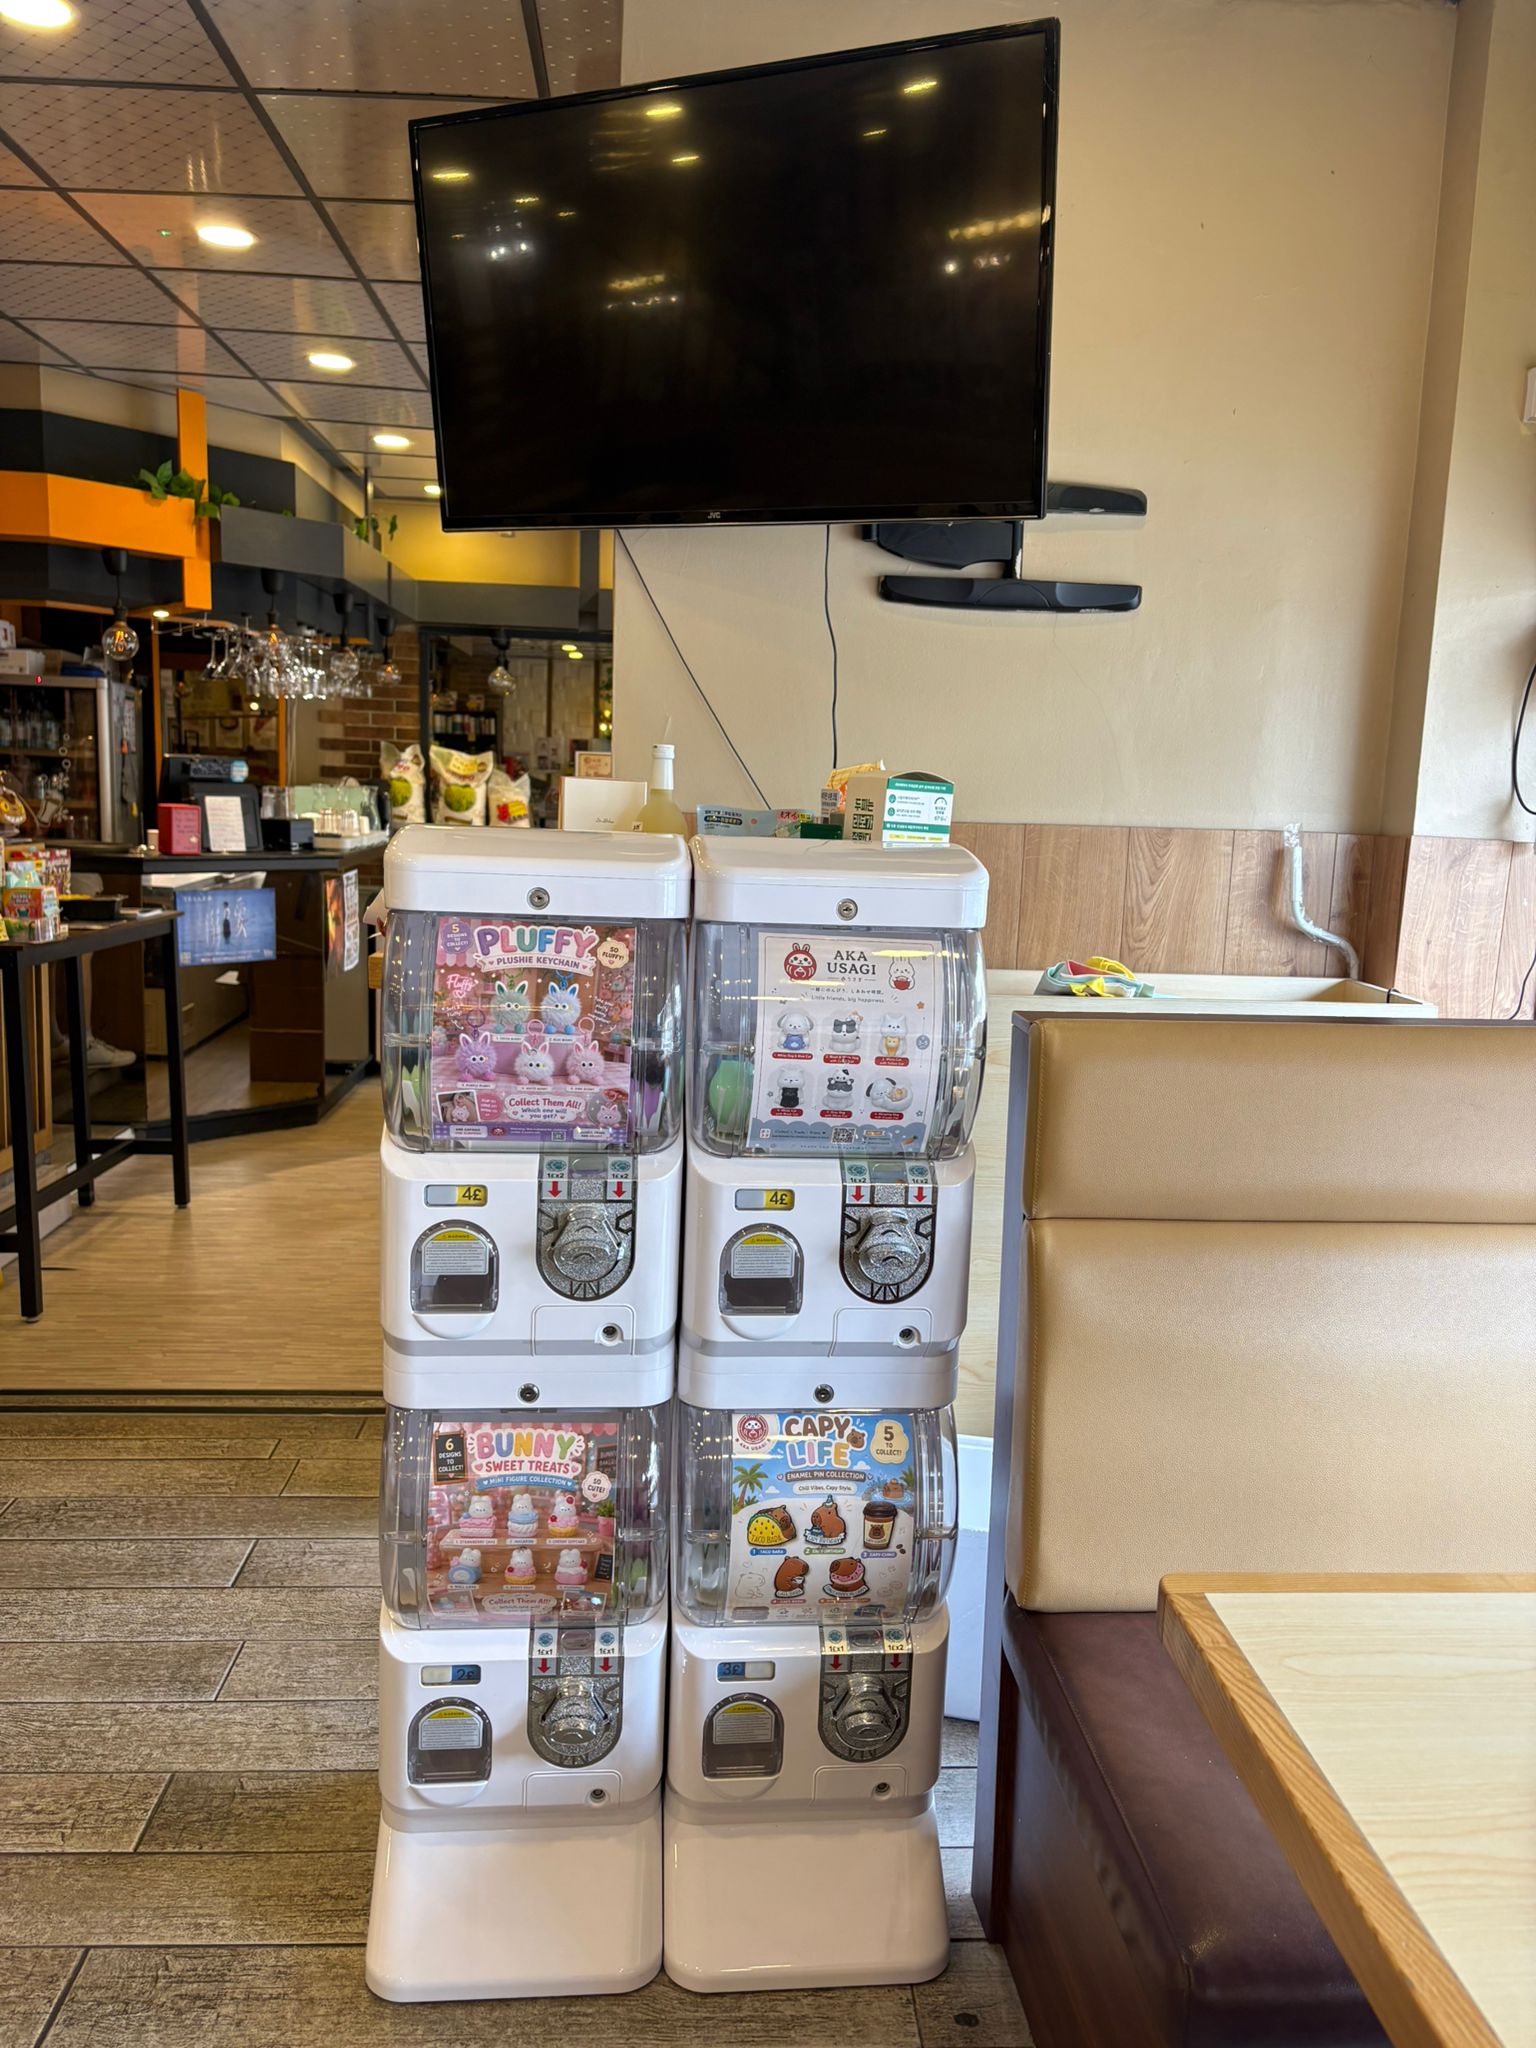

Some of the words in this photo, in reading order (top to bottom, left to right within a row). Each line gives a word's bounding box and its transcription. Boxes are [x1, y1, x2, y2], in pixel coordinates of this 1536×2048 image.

[452, 924, 460, 933] 5
[476, 928, 596, 958] PLUFFY
[496, 956, 534, 966] PLUSHIE
[536, 957, 580, 969] KEYCHAIN
[602, 952, 624, 961] FLUFFY!
[834, 950, 868, 962] AKA
[827, 962, 876, 975] USAGI
[508, 1098, 540, 1107] Collect
[542, 1098, 564, 1107] Them
[566, 1099, 582, 1110] All!
[462, 1188, 482, 1201] 4£
[770, 1190, 788, 1205] 4£
[784, 1416, 851, 1439] CAPY
[884, 1426, 894, 1441] 5
[445, 1438, 454, 1450] 6
[476, 1432, 576, 1460] BUNNY
[788, 1442, 849, 1466] LIFE
[438, 1464, 464, 1473] COLLECT!
[486, 1460, 524, 1472] SWEET
[528, 1460, 570, 1474] TREATS
[530, 1476, 566, 1485] COLLECTION
[787, 1472, 812, 1480] ENAMEL
[826, 1471, 864, 1480] COLLECTION
[723, 1663, 739, 1675] 3£
